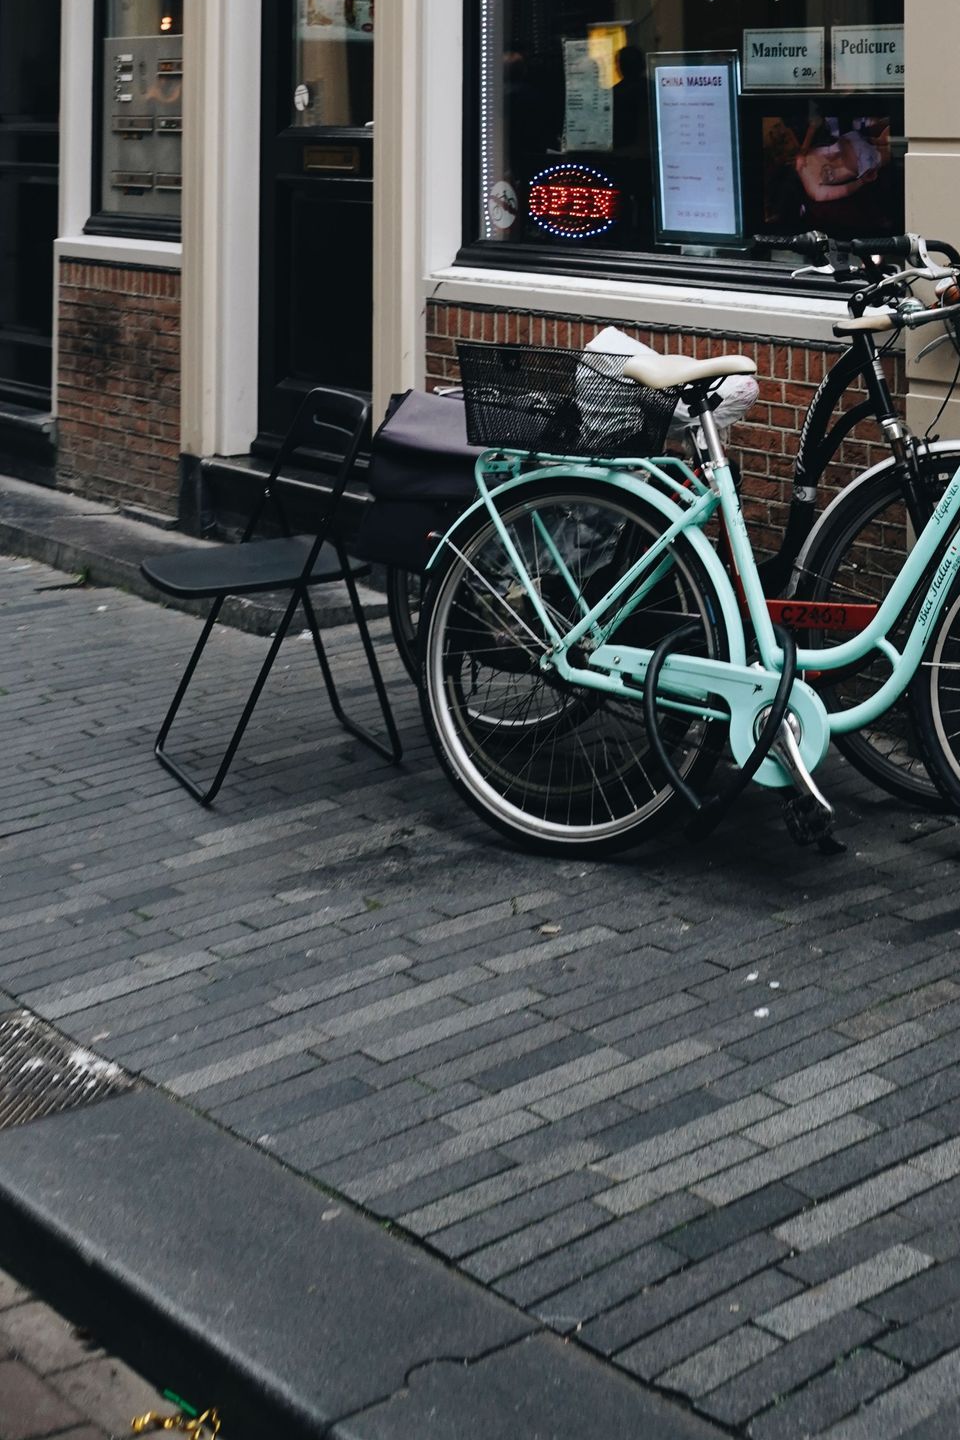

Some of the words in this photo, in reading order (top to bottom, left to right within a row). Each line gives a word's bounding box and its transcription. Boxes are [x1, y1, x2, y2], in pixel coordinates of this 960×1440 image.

[752, 42, 808, 58] Manicure
[840, 38, 896, 55] Pedicure
[793, 67, 798, 78] €
[887, 63, 892, 75] €
[661, 77, 683, 87] CHINA
[687, 76, 722, 87] MASSAGE
[529, 185, 613, 220] OPEN
[918, 599, 933, 626] Bici
[930, 559, 952, 598] Italia
